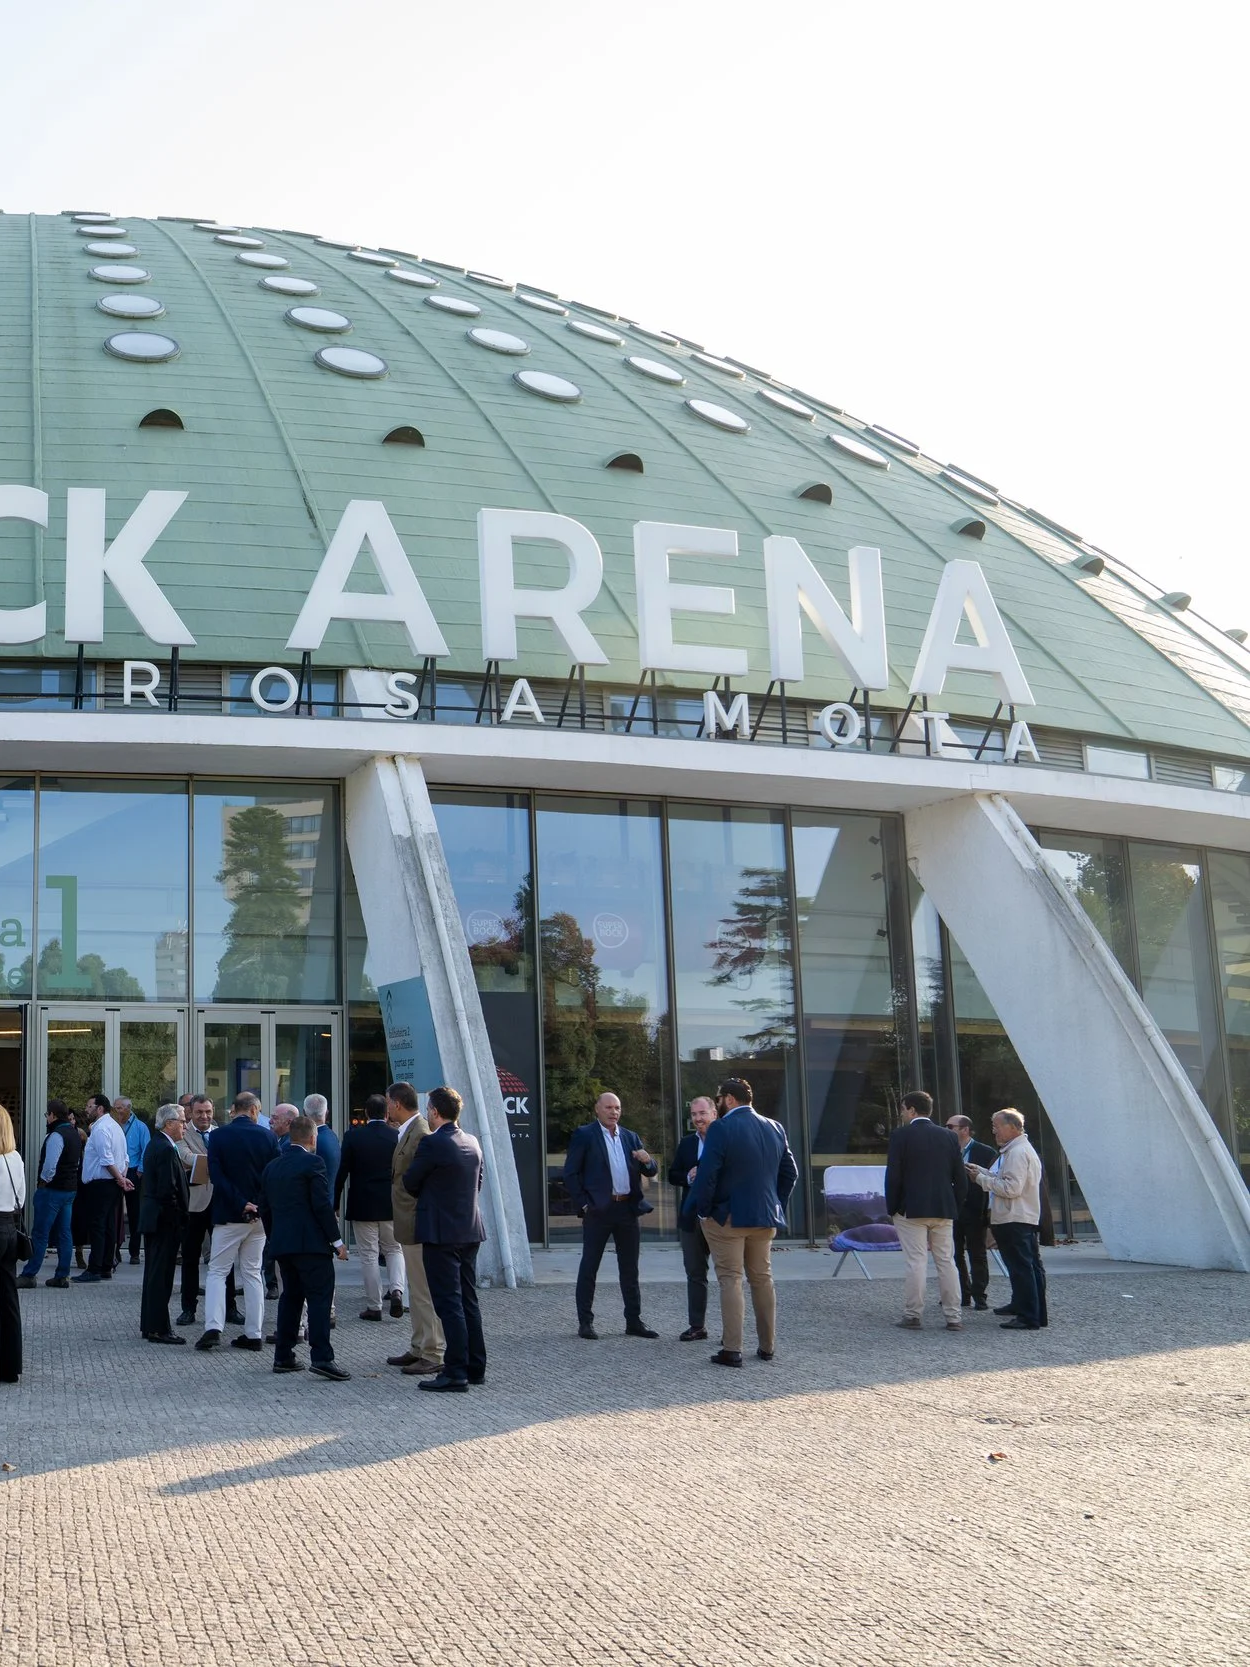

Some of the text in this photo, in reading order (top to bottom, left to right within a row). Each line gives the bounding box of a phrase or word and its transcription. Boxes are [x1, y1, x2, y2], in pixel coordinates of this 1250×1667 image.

[285, 500, 1035, 706] ARENA
[123, 660, 545, 724] ROSA
[703, 691, 1041, 763] MOTA
[46, 875, 92, 988] 1
[471, 919, 498, 927] SUPER
[473, 927, 498, 936] BOCK
[600, 928, 623, 937] BOCK
[503, 1096, 530, 1114] CK
